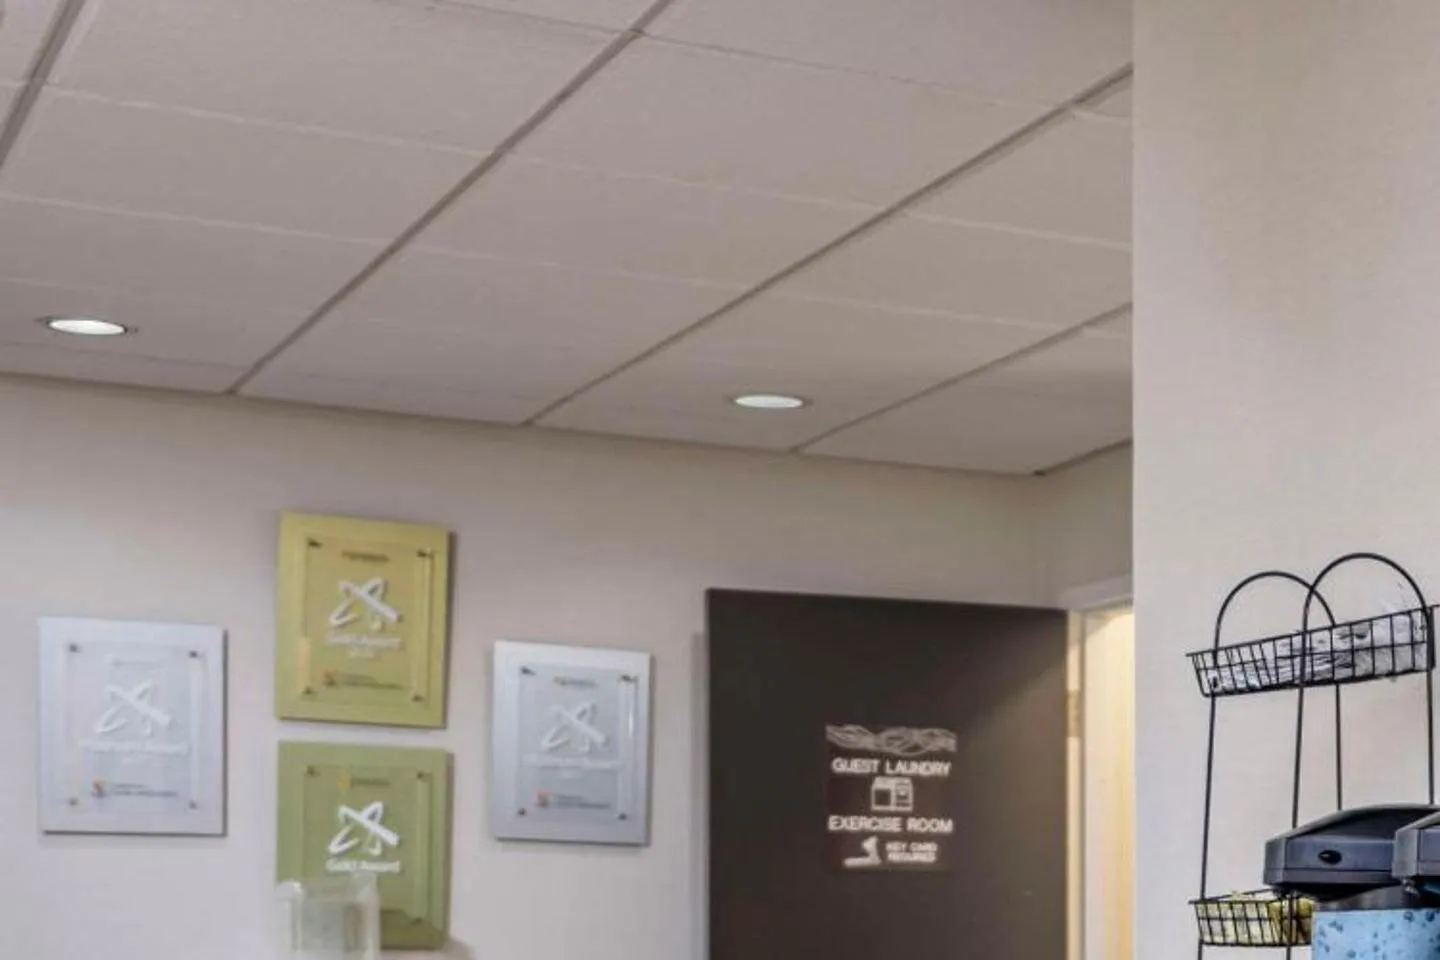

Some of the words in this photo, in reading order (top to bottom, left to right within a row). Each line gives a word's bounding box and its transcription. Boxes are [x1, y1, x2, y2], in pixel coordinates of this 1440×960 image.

[831, 757, 879, 774] GUEST
[885, 759, 951, 777] LAUNDRY
[828, 815, 902, 832] EXERCISE
[906, 817, 953, 833] ROOM
